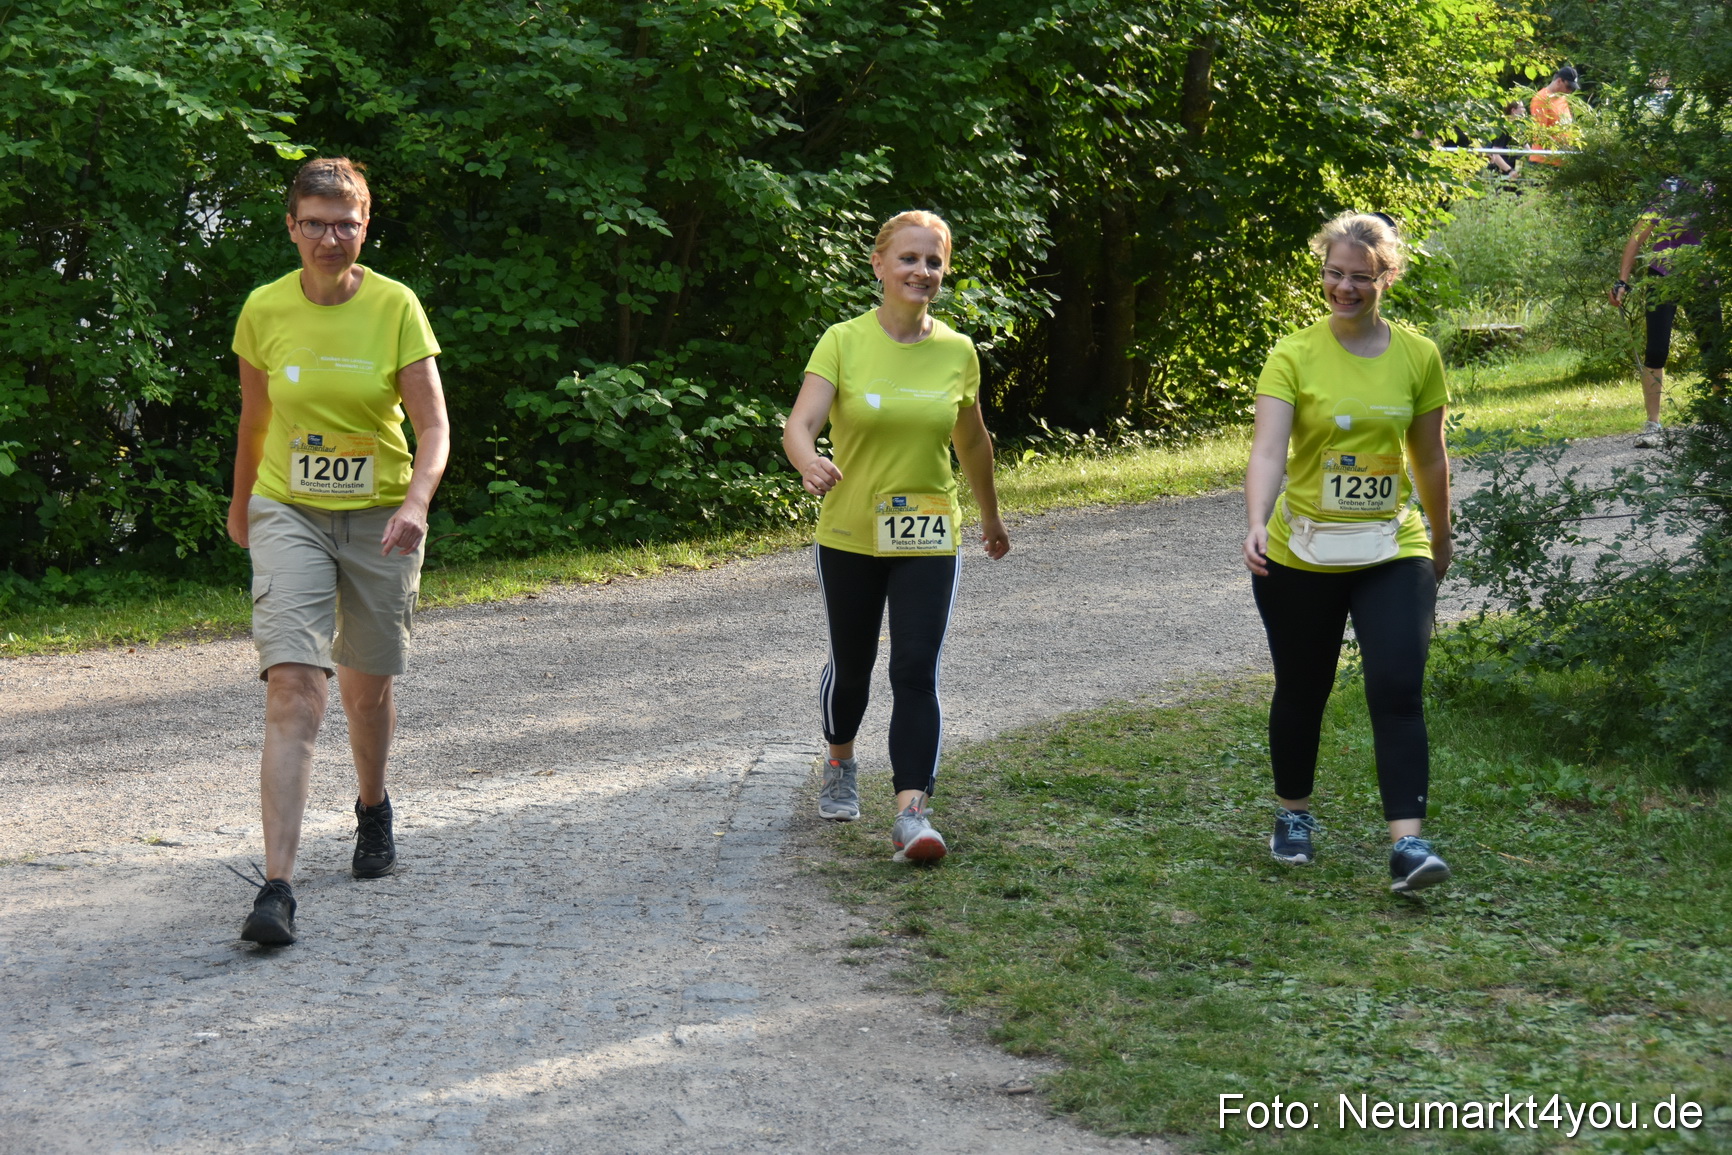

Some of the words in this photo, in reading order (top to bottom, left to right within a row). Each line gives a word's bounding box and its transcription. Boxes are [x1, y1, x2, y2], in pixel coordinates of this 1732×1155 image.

[298, 454, 368, 481] 1207
[300, 479, 331, 489] Borchert
[1330, 474, 1393, 500] 1230
[1337, 498, 1366, 507] Grebner
[1367, 499, 1384, 507] Tanja
[884, 515, 946, 539] 1274
